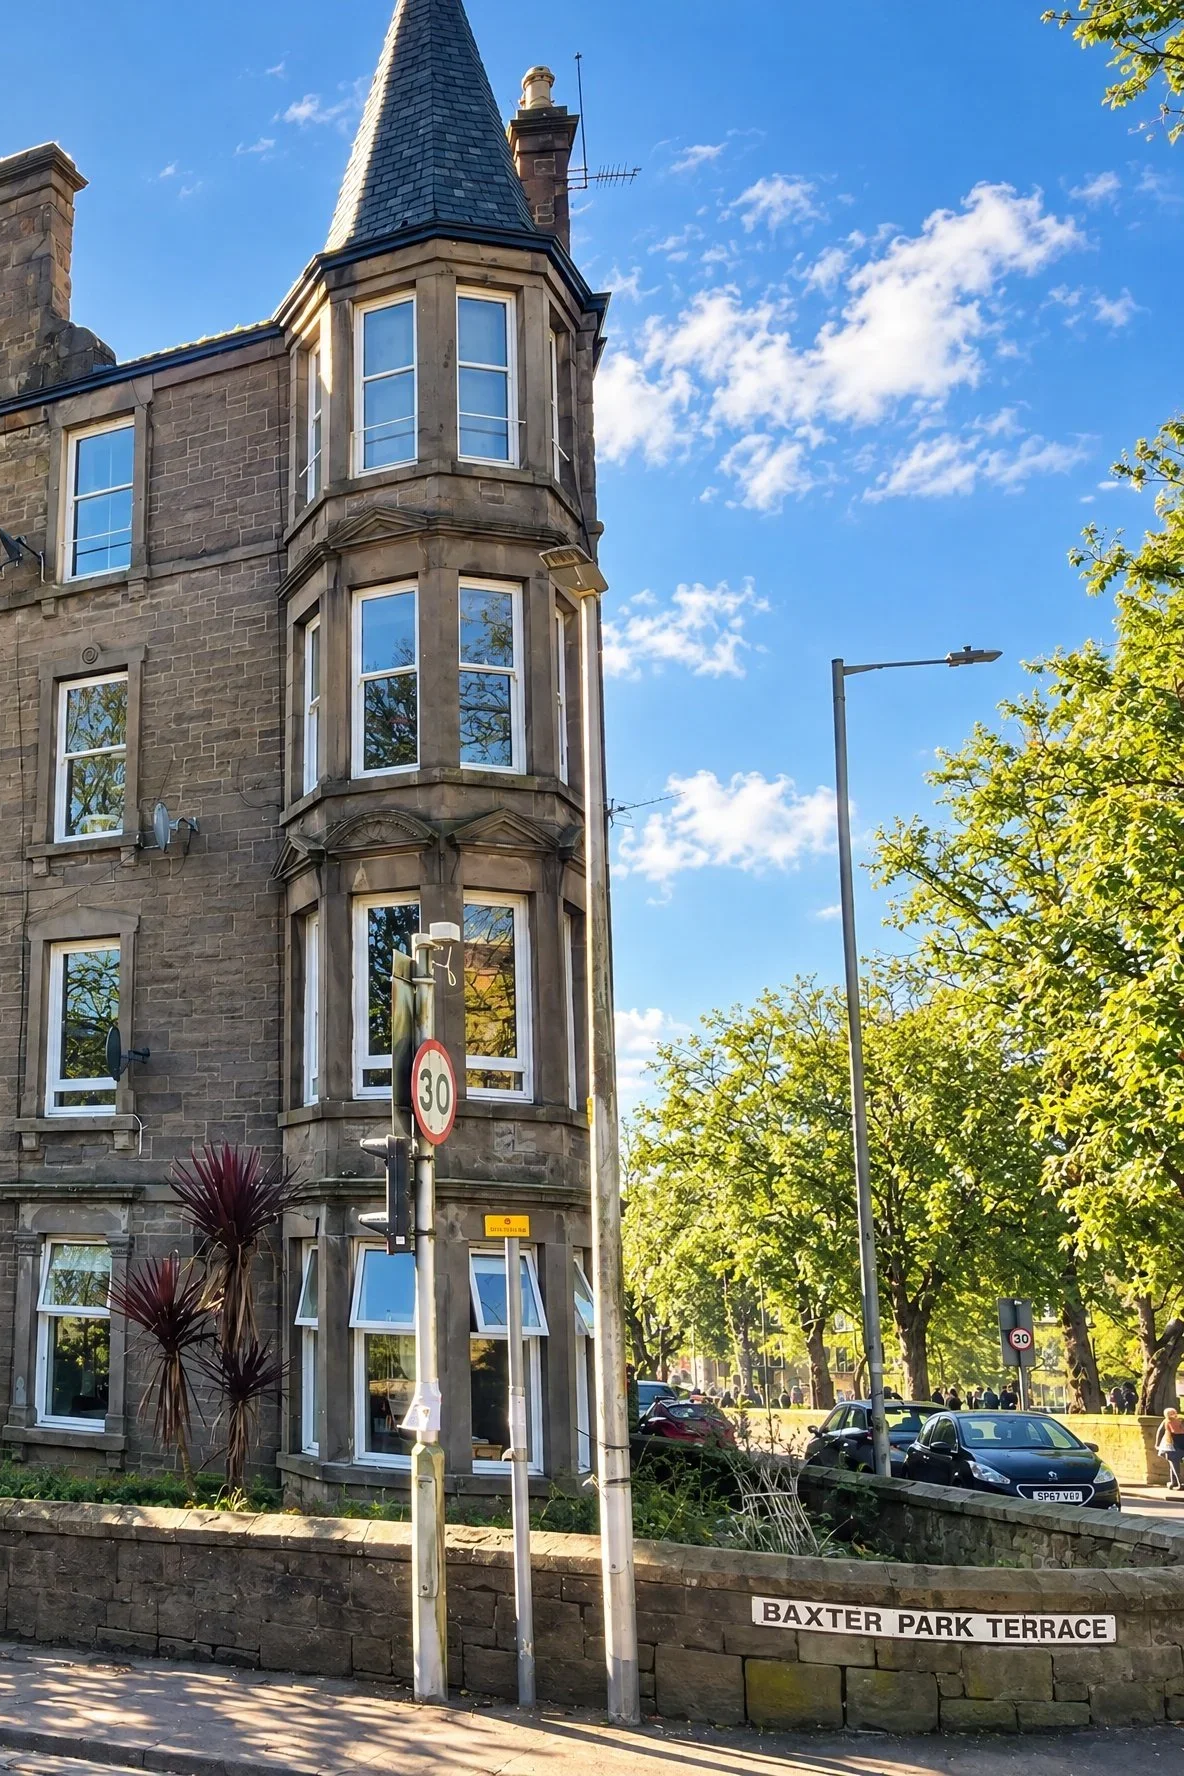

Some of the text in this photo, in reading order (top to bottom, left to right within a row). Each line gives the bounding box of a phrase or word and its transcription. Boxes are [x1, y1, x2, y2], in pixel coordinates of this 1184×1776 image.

[419, 1068, 450, 1115] 30
[1014, 1333, 1029, 1344] 30
[1037, 1492, 1061, 1501] SP67
[763, 1602, 1107, 1639] BAXTER PARK TERRACE
